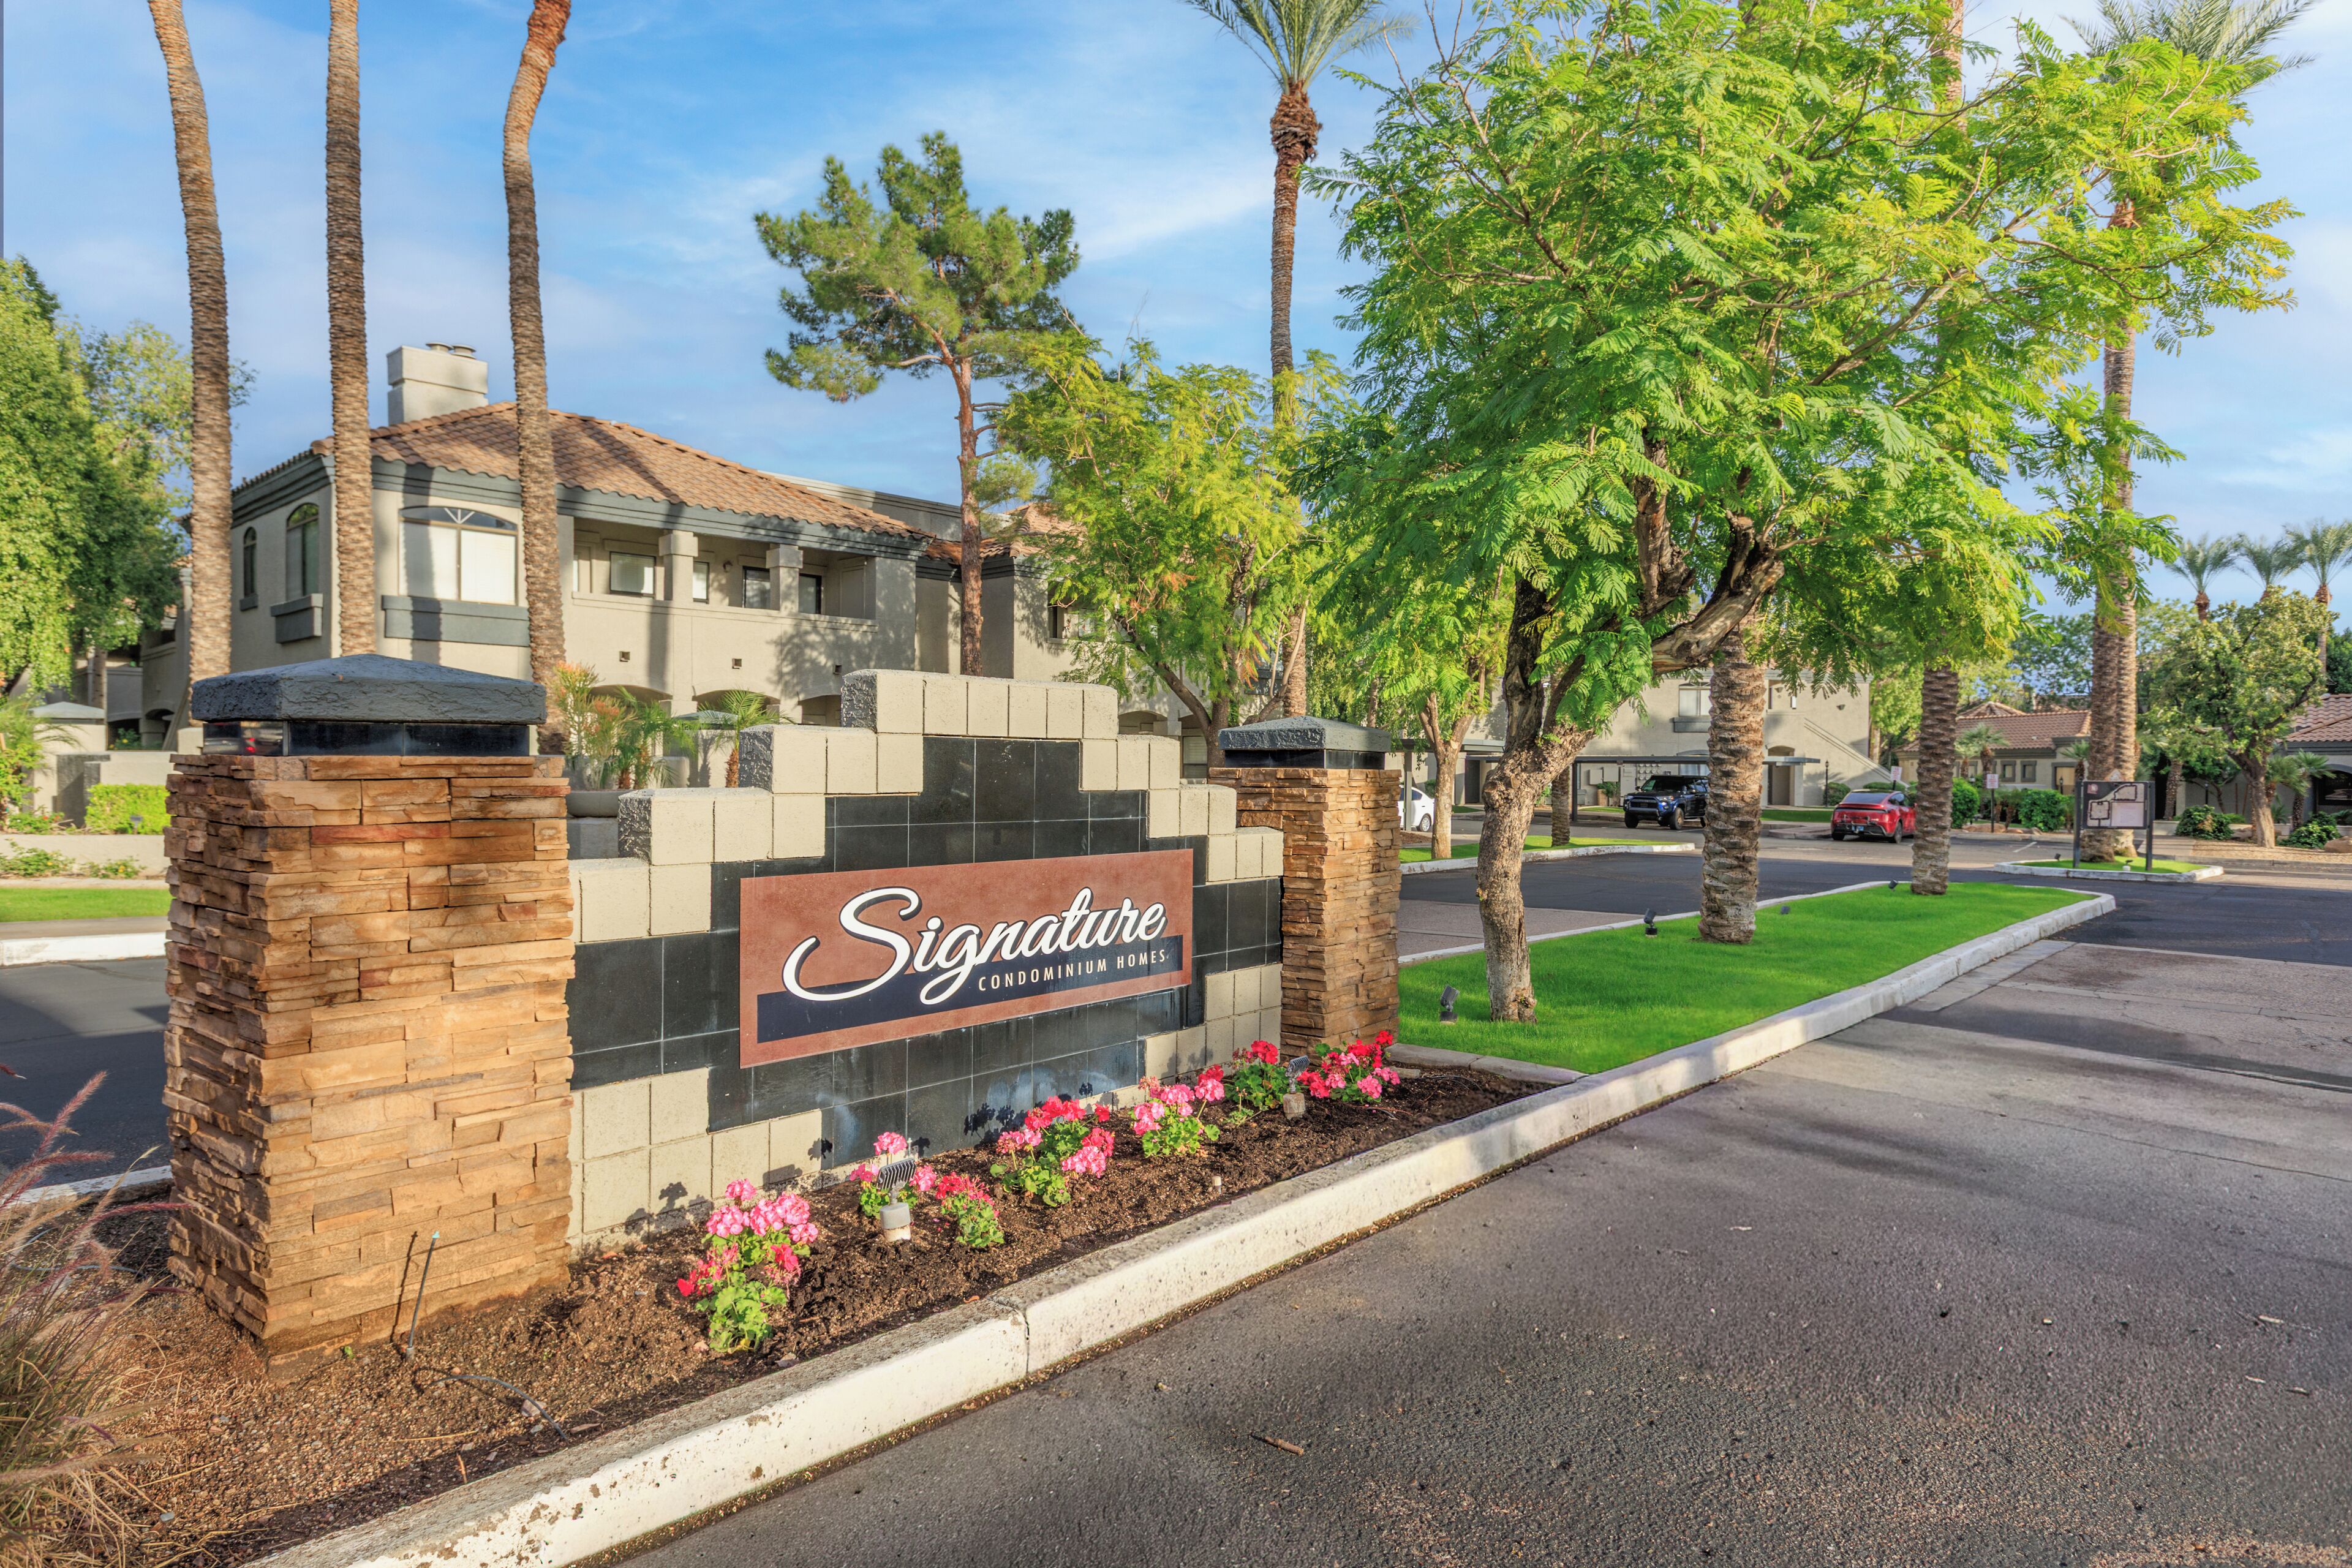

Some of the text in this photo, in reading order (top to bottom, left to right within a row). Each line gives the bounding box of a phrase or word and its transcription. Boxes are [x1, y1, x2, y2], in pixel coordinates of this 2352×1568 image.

[782, 886, 1167, 1006] Signature
[978, 949, 1166, 992] CONDOMINIUM HOMES
